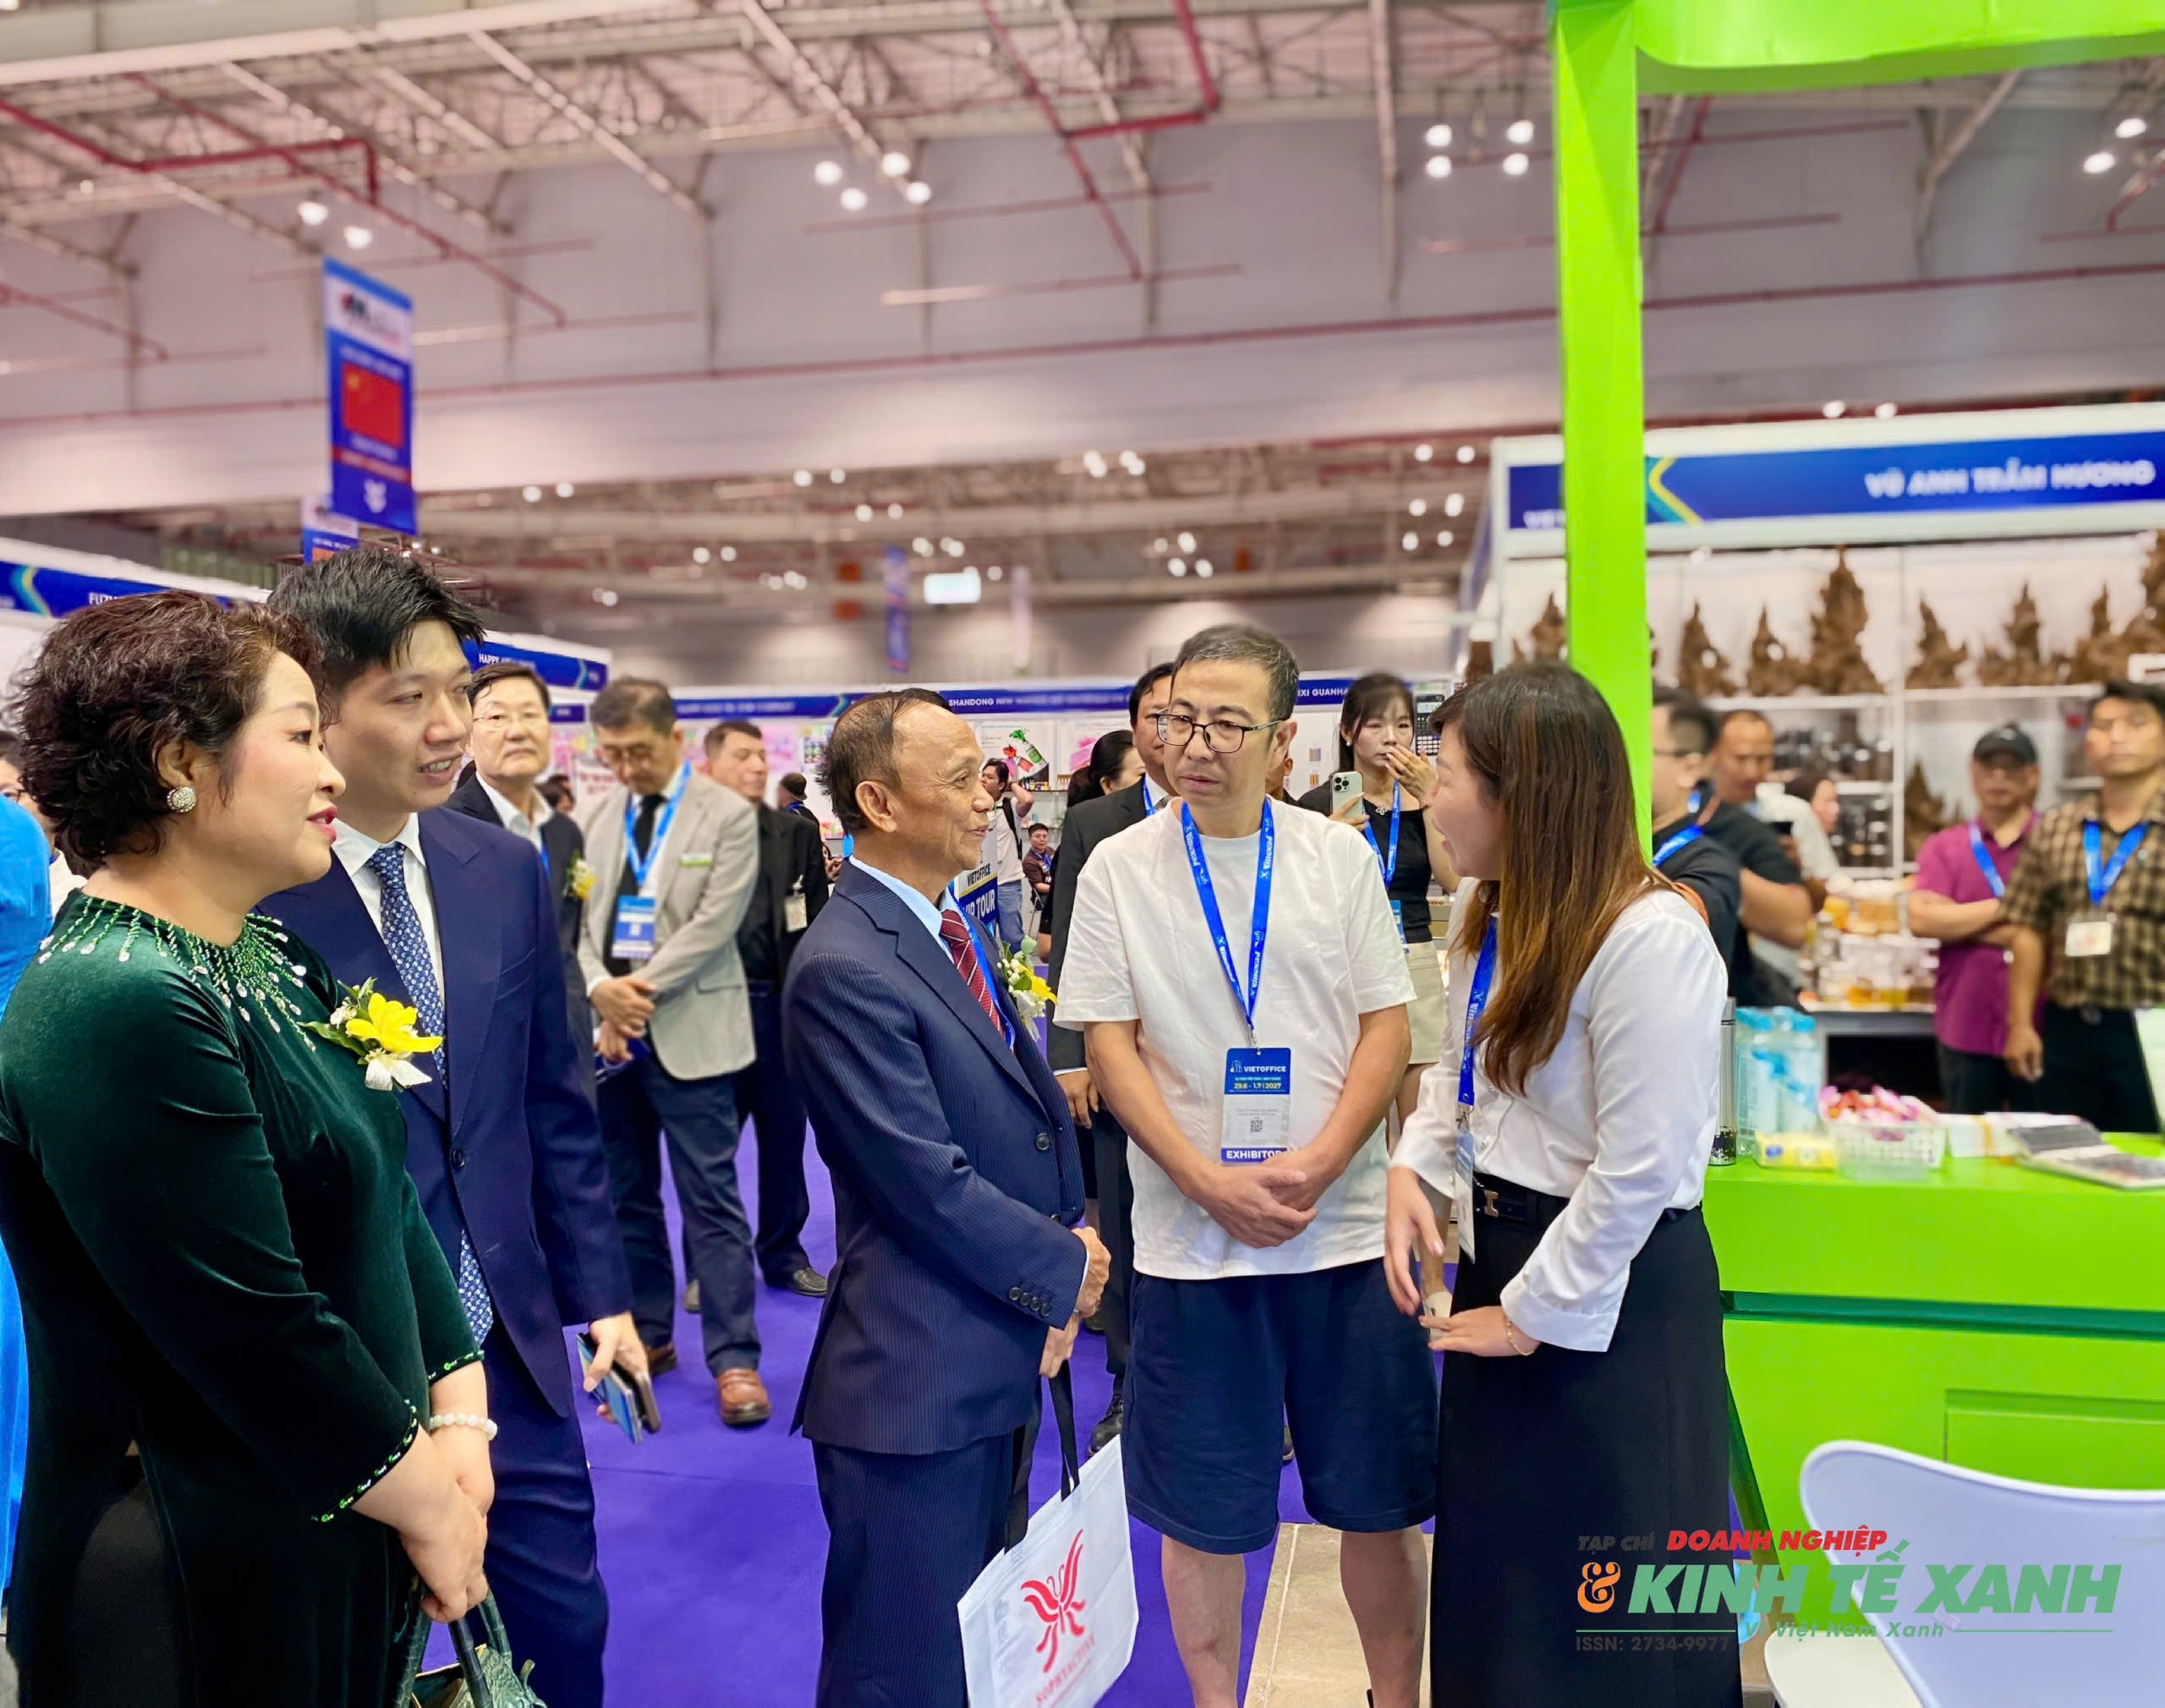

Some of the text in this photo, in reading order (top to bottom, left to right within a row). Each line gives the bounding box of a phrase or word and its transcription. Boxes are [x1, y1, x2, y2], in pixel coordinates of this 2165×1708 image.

[479, 653, 500, 665] HAPPY
[948, 698, 994, 707] SHANDONG
[967, 863, 990, 887] VIETOFFICE
[976, 889, 995, 920] TOUR
